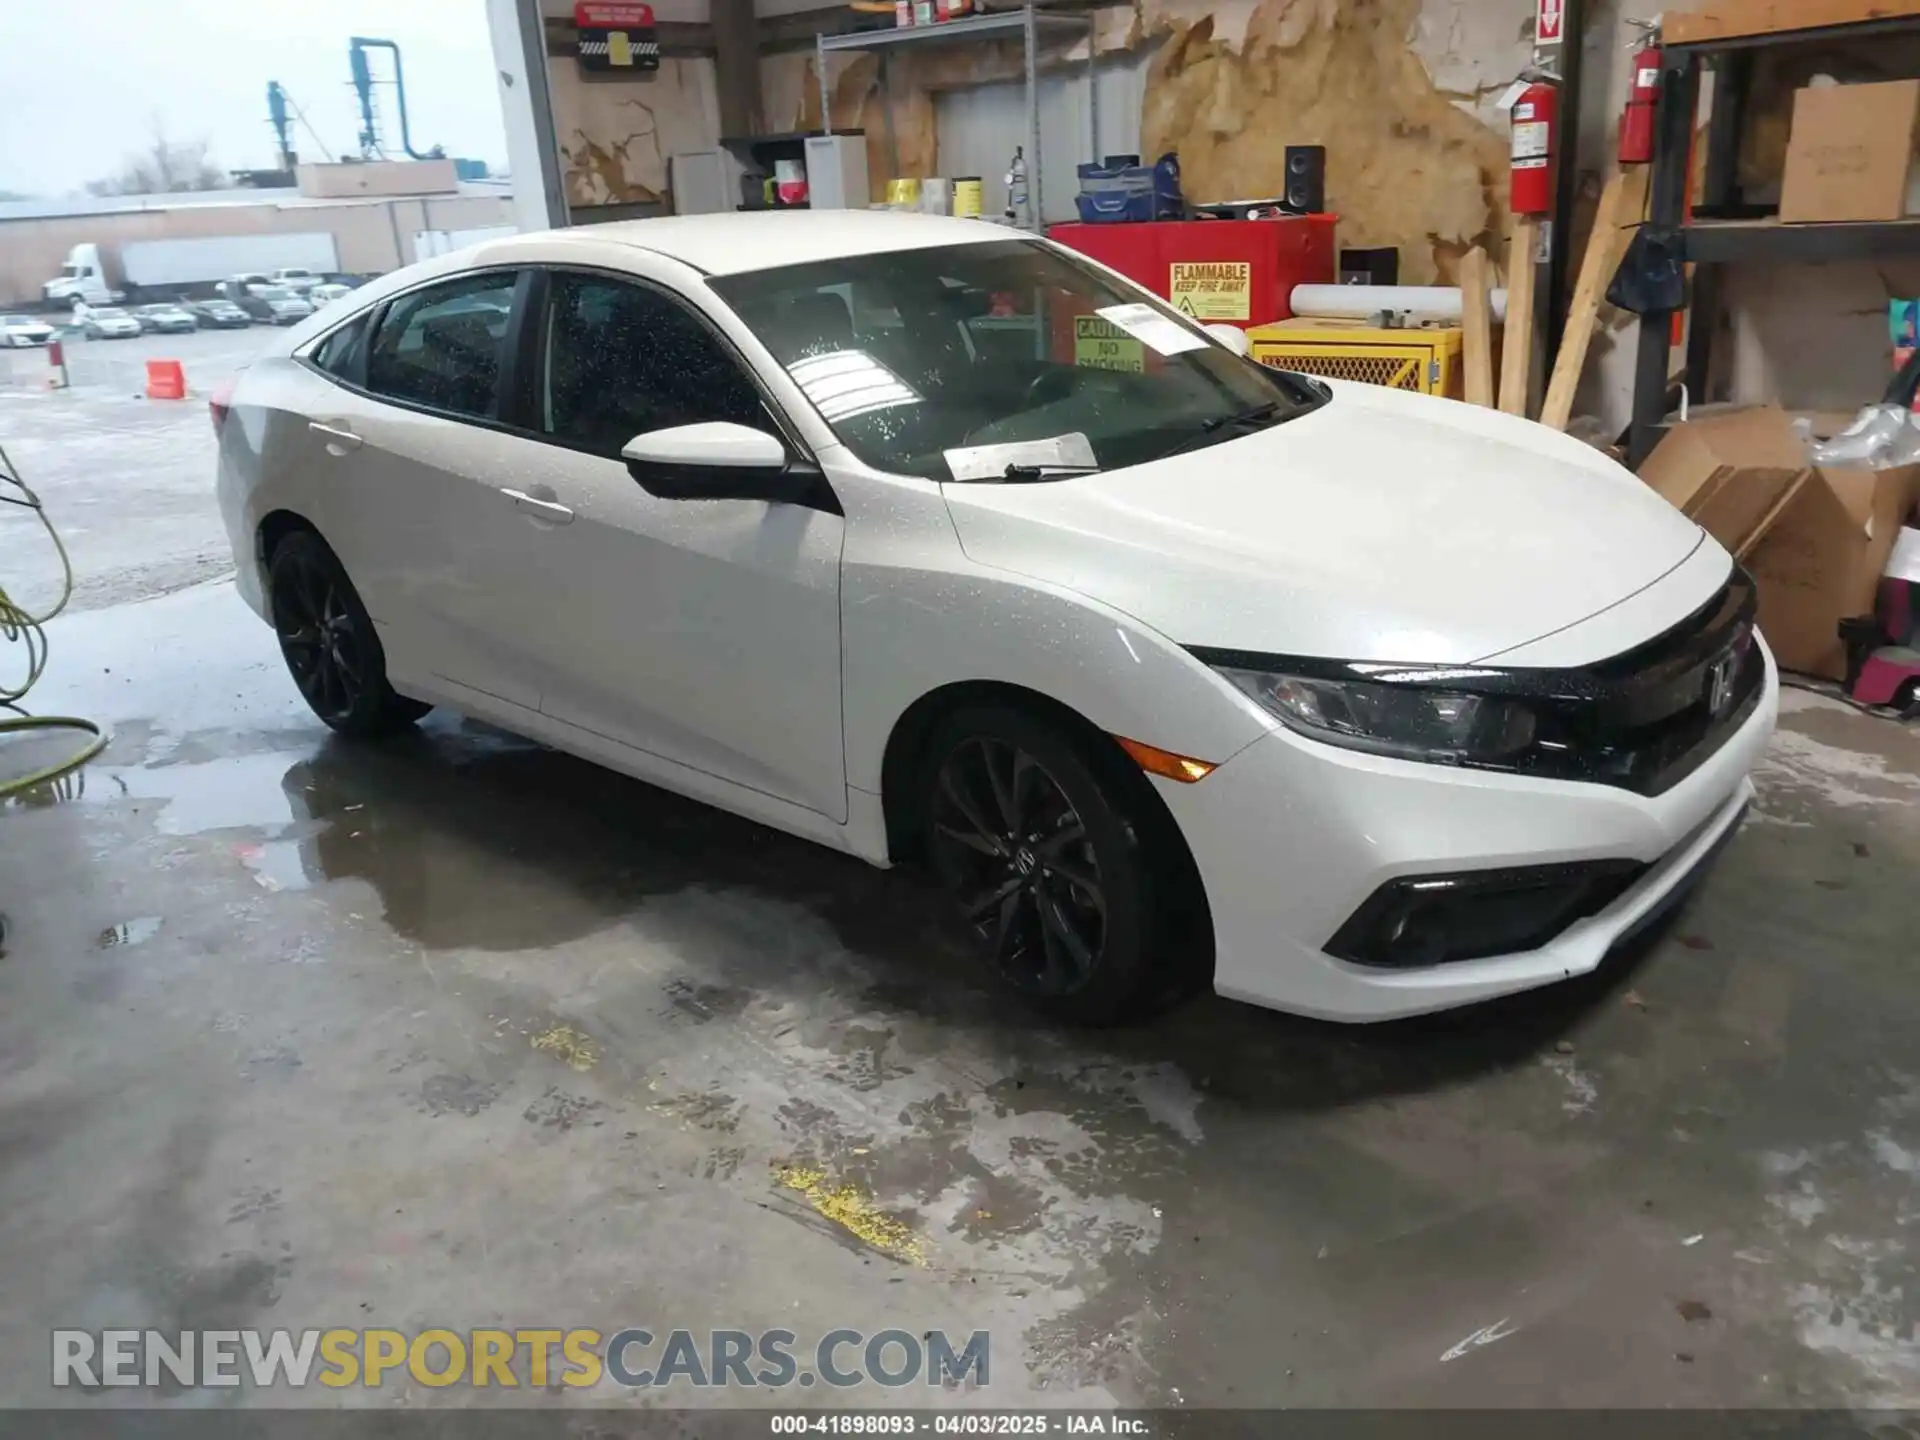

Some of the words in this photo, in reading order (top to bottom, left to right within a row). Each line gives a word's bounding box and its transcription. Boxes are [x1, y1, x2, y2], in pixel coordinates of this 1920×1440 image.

[1174, 265, 1247, 280] FLAMMABLE
[1174, 281, 1197, 293] KEEP
[1198, 281, 1219, 293] FIRE
[1079, 320, 1130, 337] CAUTI
[1098, 341, 1119, 355] NO
